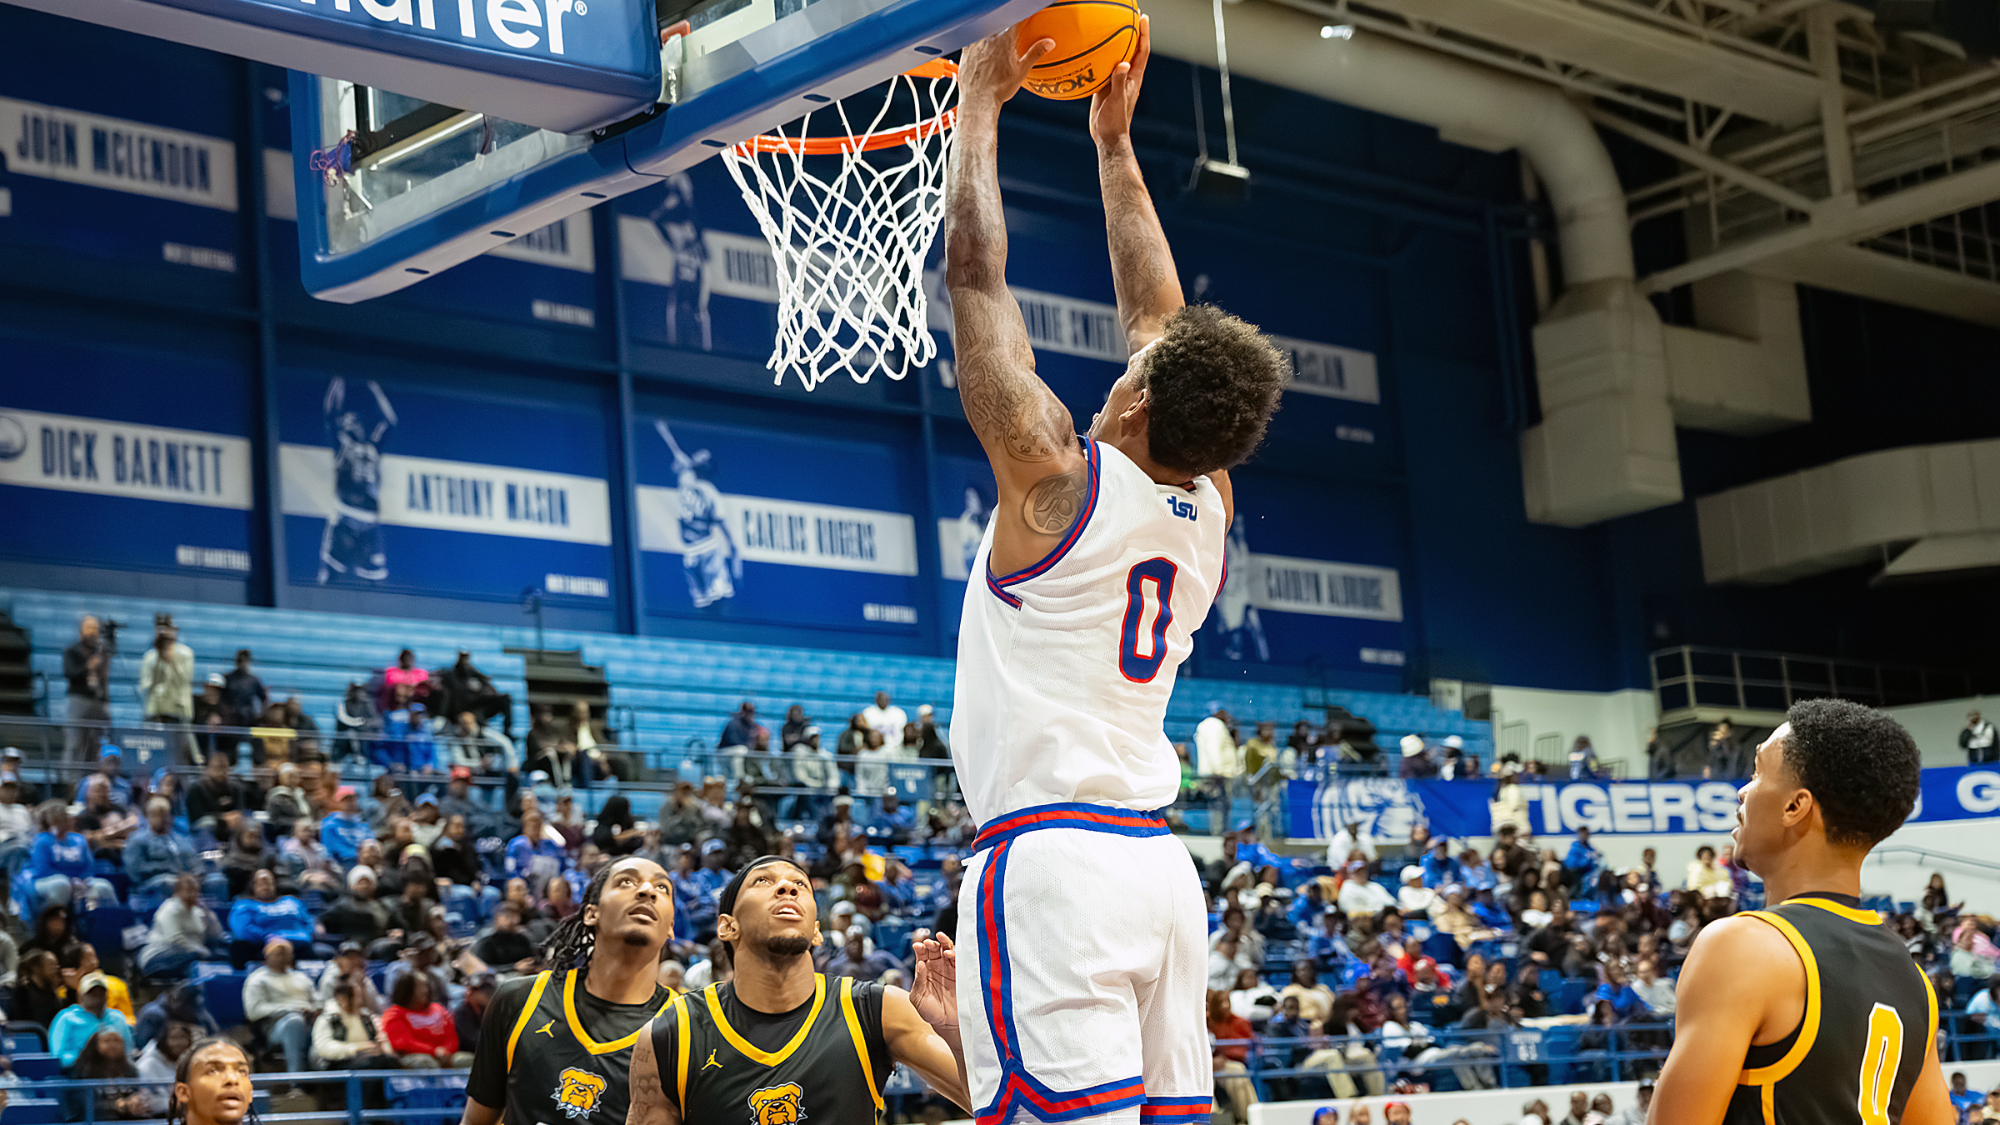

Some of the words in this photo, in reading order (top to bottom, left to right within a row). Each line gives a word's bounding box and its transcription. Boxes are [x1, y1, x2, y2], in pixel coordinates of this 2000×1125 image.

[1027, 68, 1097, 94] NCAA
[17, 112, 77, 168] JOHN
[91, 126, 211, 191] MCLENDON
[40, 425, 98, 480] DICK
[113, 434, 221, 495] BARNETT
[407, 473, 493, 519] ANTHONY
[506, 483, 568, 527] MASON
[744, 509, 806, 553] CARLOS
[816, 517, 877, 561] ROGERS
[1119, 556, 1178, 684] 0
[1858, 1001, 1903, 1125] 0
